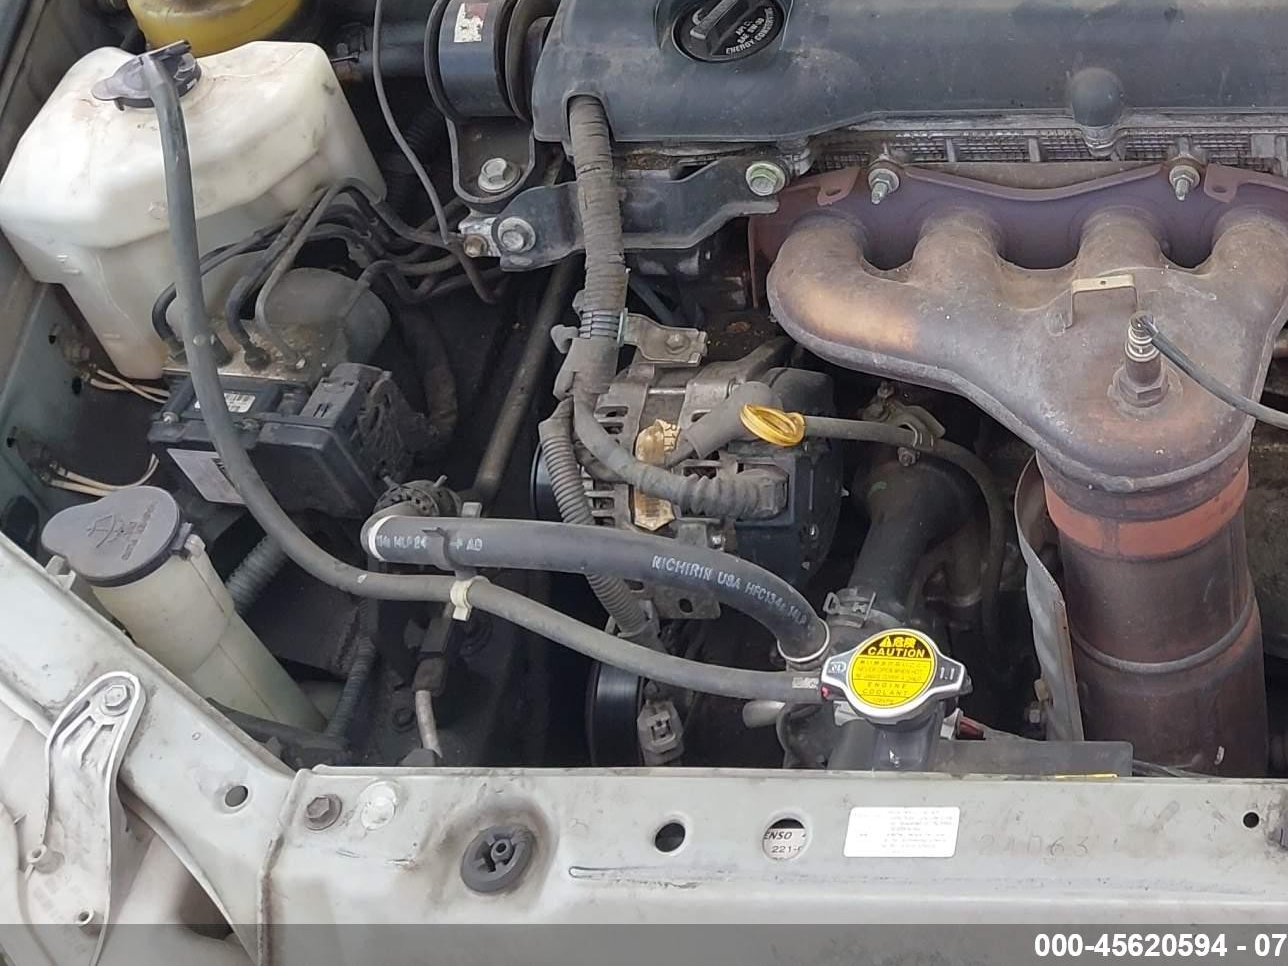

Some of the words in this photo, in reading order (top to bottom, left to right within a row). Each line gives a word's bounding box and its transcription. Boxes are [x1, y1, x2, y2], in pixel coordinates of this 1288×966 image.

[726, 38, 755, 55] ENERGY
[652, 555, 713, 582] NICHIRIN
[717, 571, 743, 591] USA
[867, 646, 925, 658] CAUTION
[867, 682, 908, 690] ENGINE
[862, 688, 909, 696] COOLANT
[763, 830, 793, 840] ENSO
